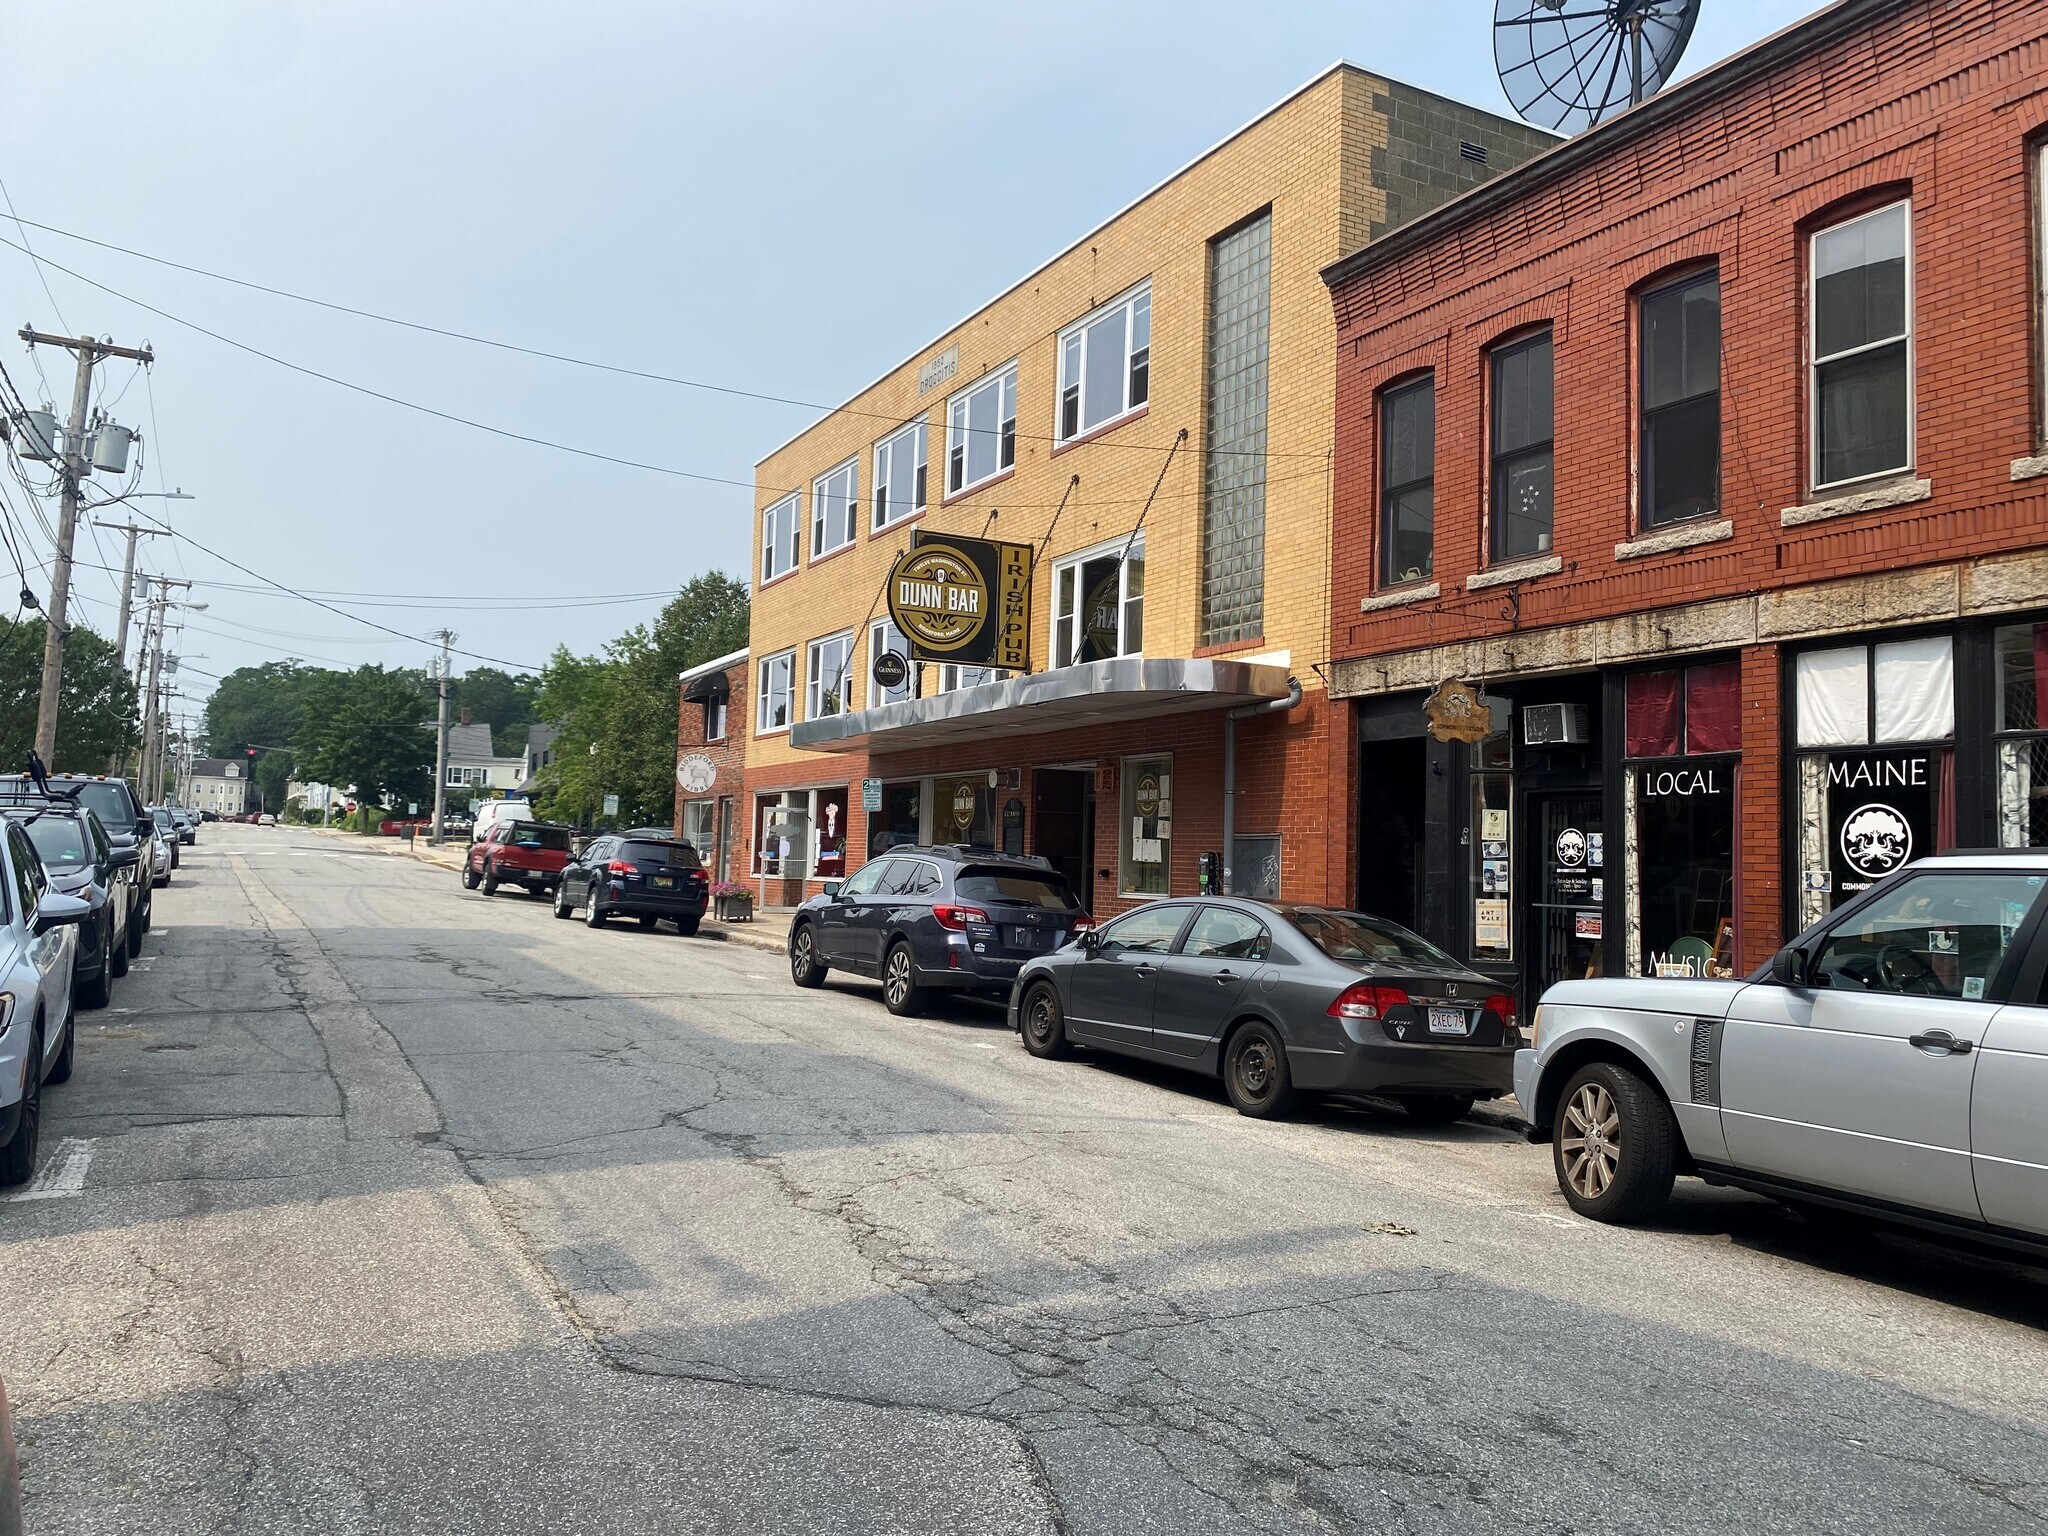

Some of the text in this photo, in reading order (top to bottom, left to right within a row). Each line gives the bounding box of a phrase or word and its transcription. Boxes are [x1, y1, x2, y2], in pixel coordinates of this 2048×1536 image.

[913, 560, 930, 572] TWELVE
[930, 558, 962, 573] WASHINGTON
[1005, 550, 1024, 617] IRISH
[900, 581, 979, 613] DUNN BAR
[945, 627, 961, 637] MAINE
[1004, 623, 1023, 663] PUB
[679, 755, 715, 772] BIDDEFORD
[1825, 758, 1927, 788] MAINE
[685, 783, 710, 792] FIBRE
[863, 780, 869, 789] 2
[1646, 770, 1720, 795] LOCAL
[1648, 951, 1718, 978] MUSIC
[1431, 1014, 1464, 1028] 2XEC 79
